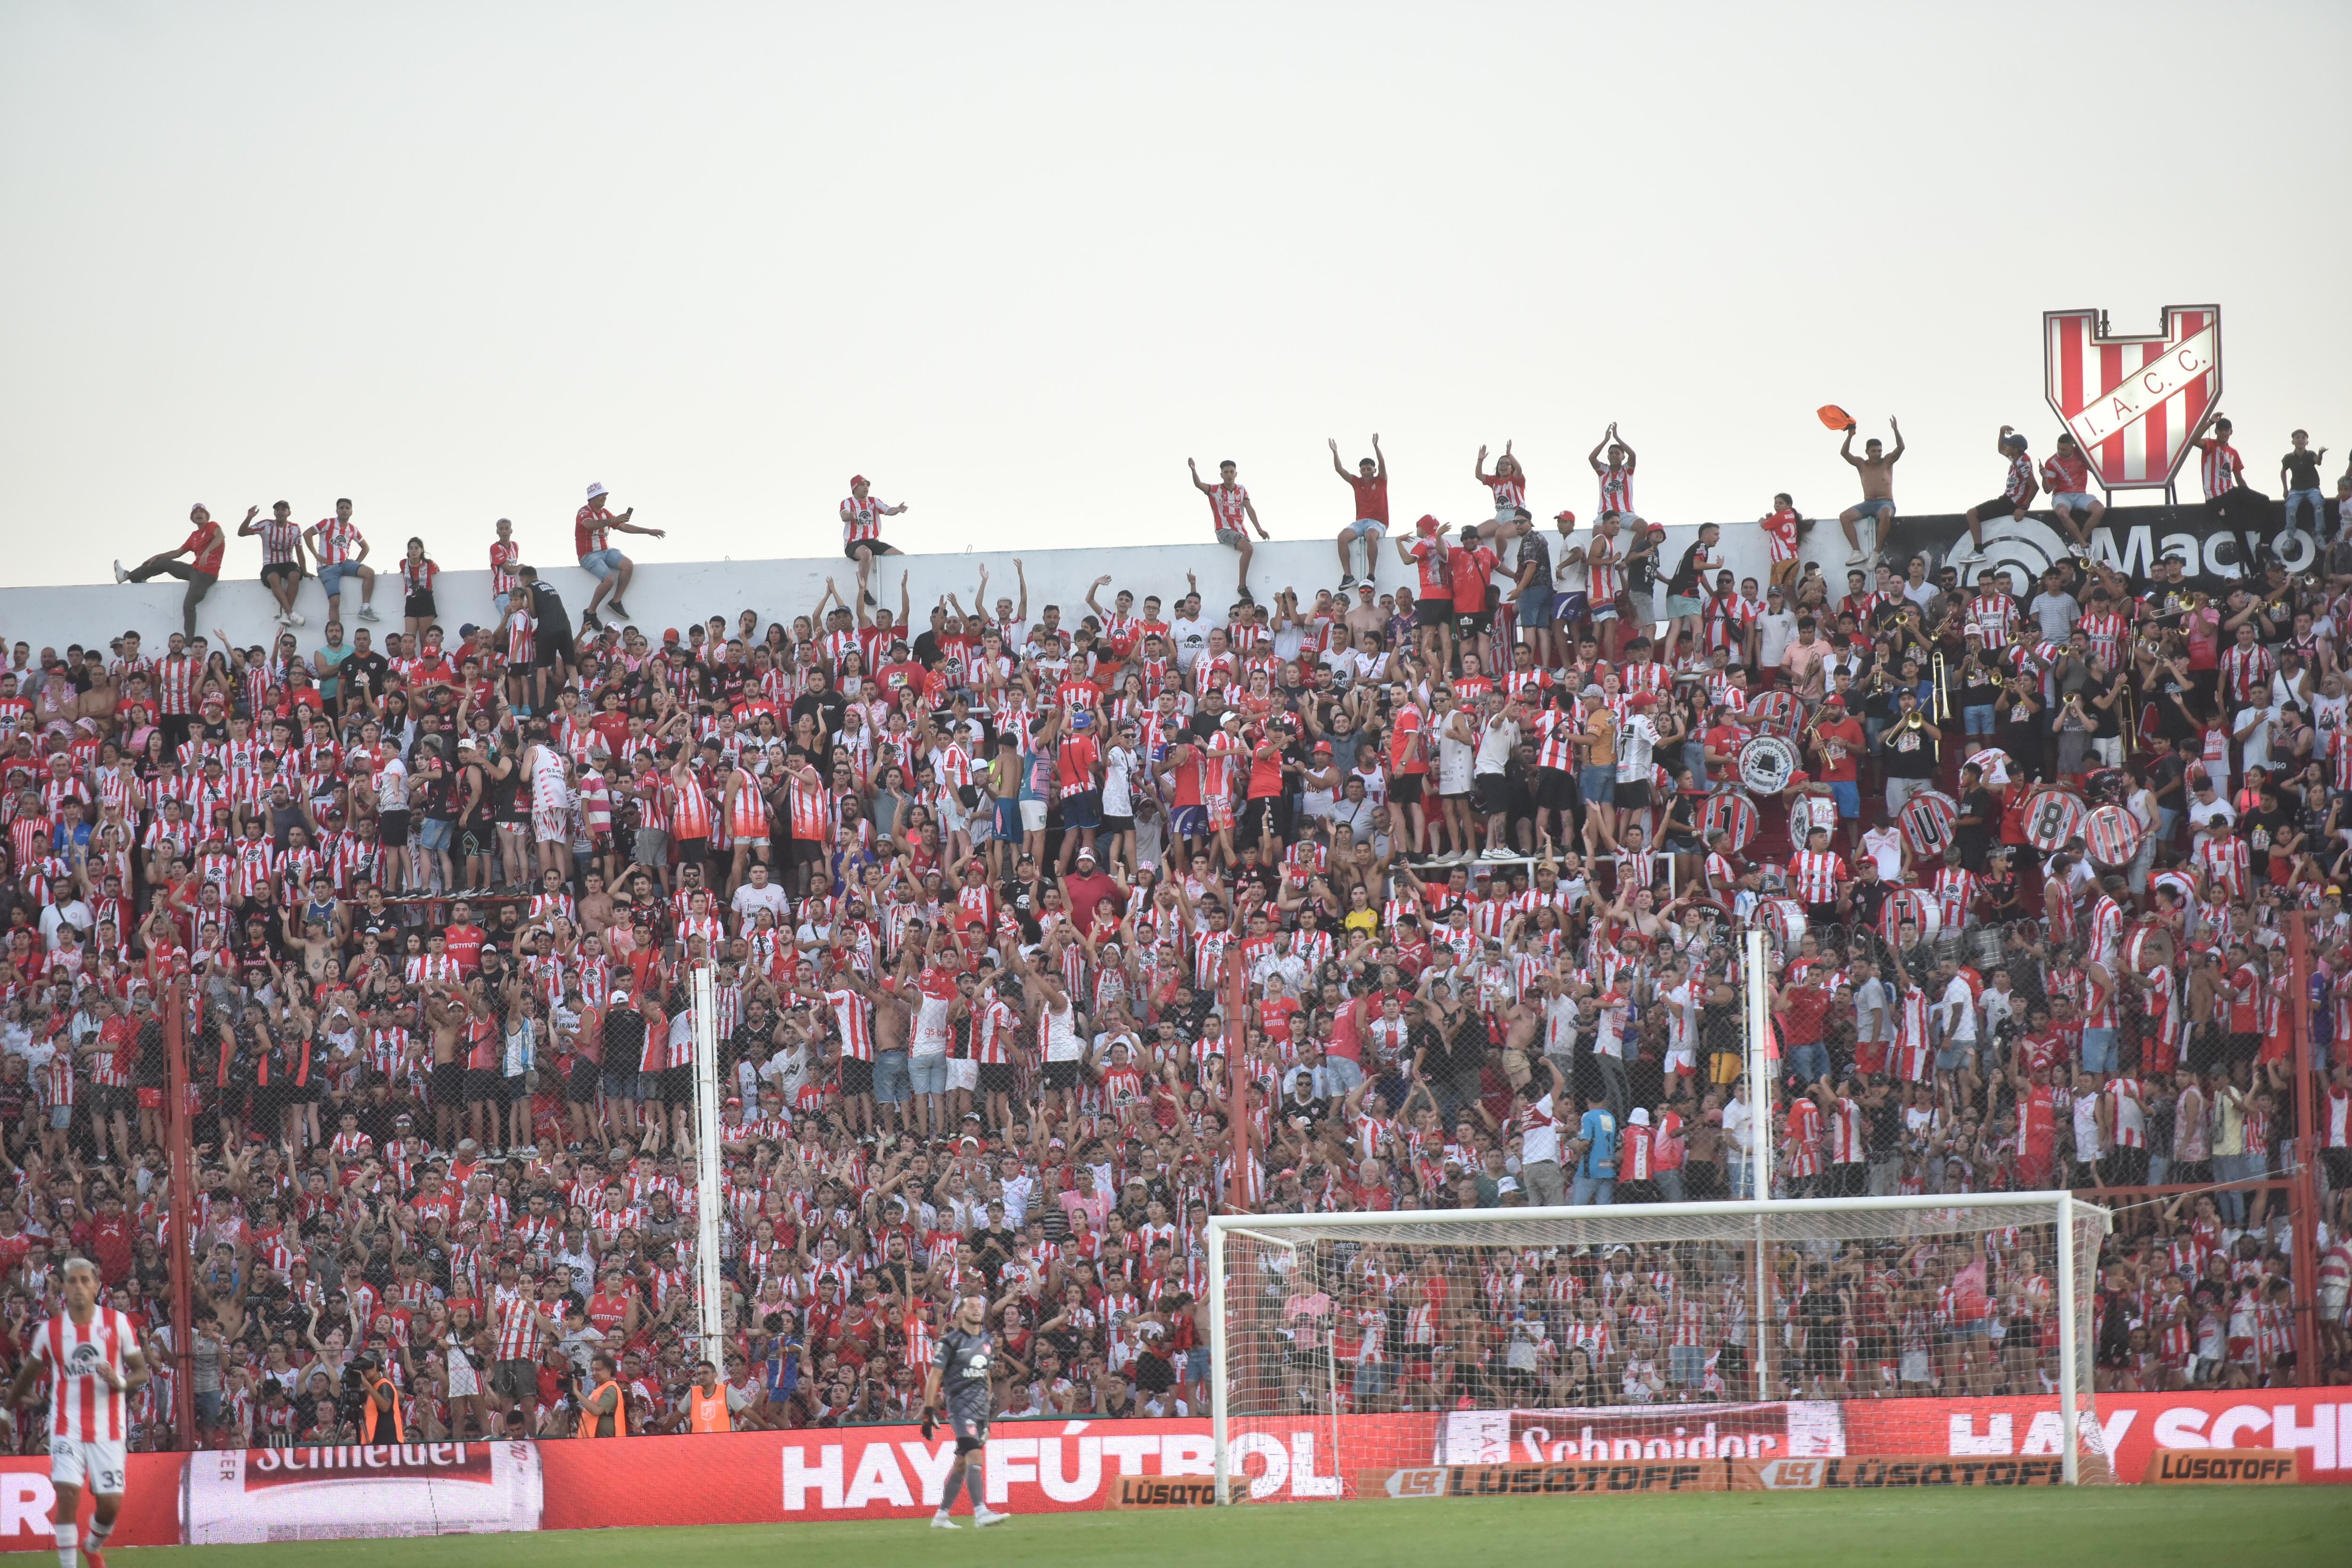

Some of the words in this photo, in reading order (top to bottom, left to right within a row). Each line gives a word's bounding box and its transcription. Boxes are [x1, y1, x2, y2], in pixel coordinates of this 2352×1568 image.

[548, 751, 559, 767] 3
[1913, 804, 1941, 846] U
[2038, 800, 2065, 840] 8
[2101, 813, 2118, 855] T
[1895, 898, 1909, 921] T
[542, 970, 555, 979] acro
[581, 973, 602, 982] Macro
[102, 1470, 124, 1488] 33
[782, 1441, 958, 1511] HAY
[2161, 1454, 2292, 1480] LÜSQTOFF
